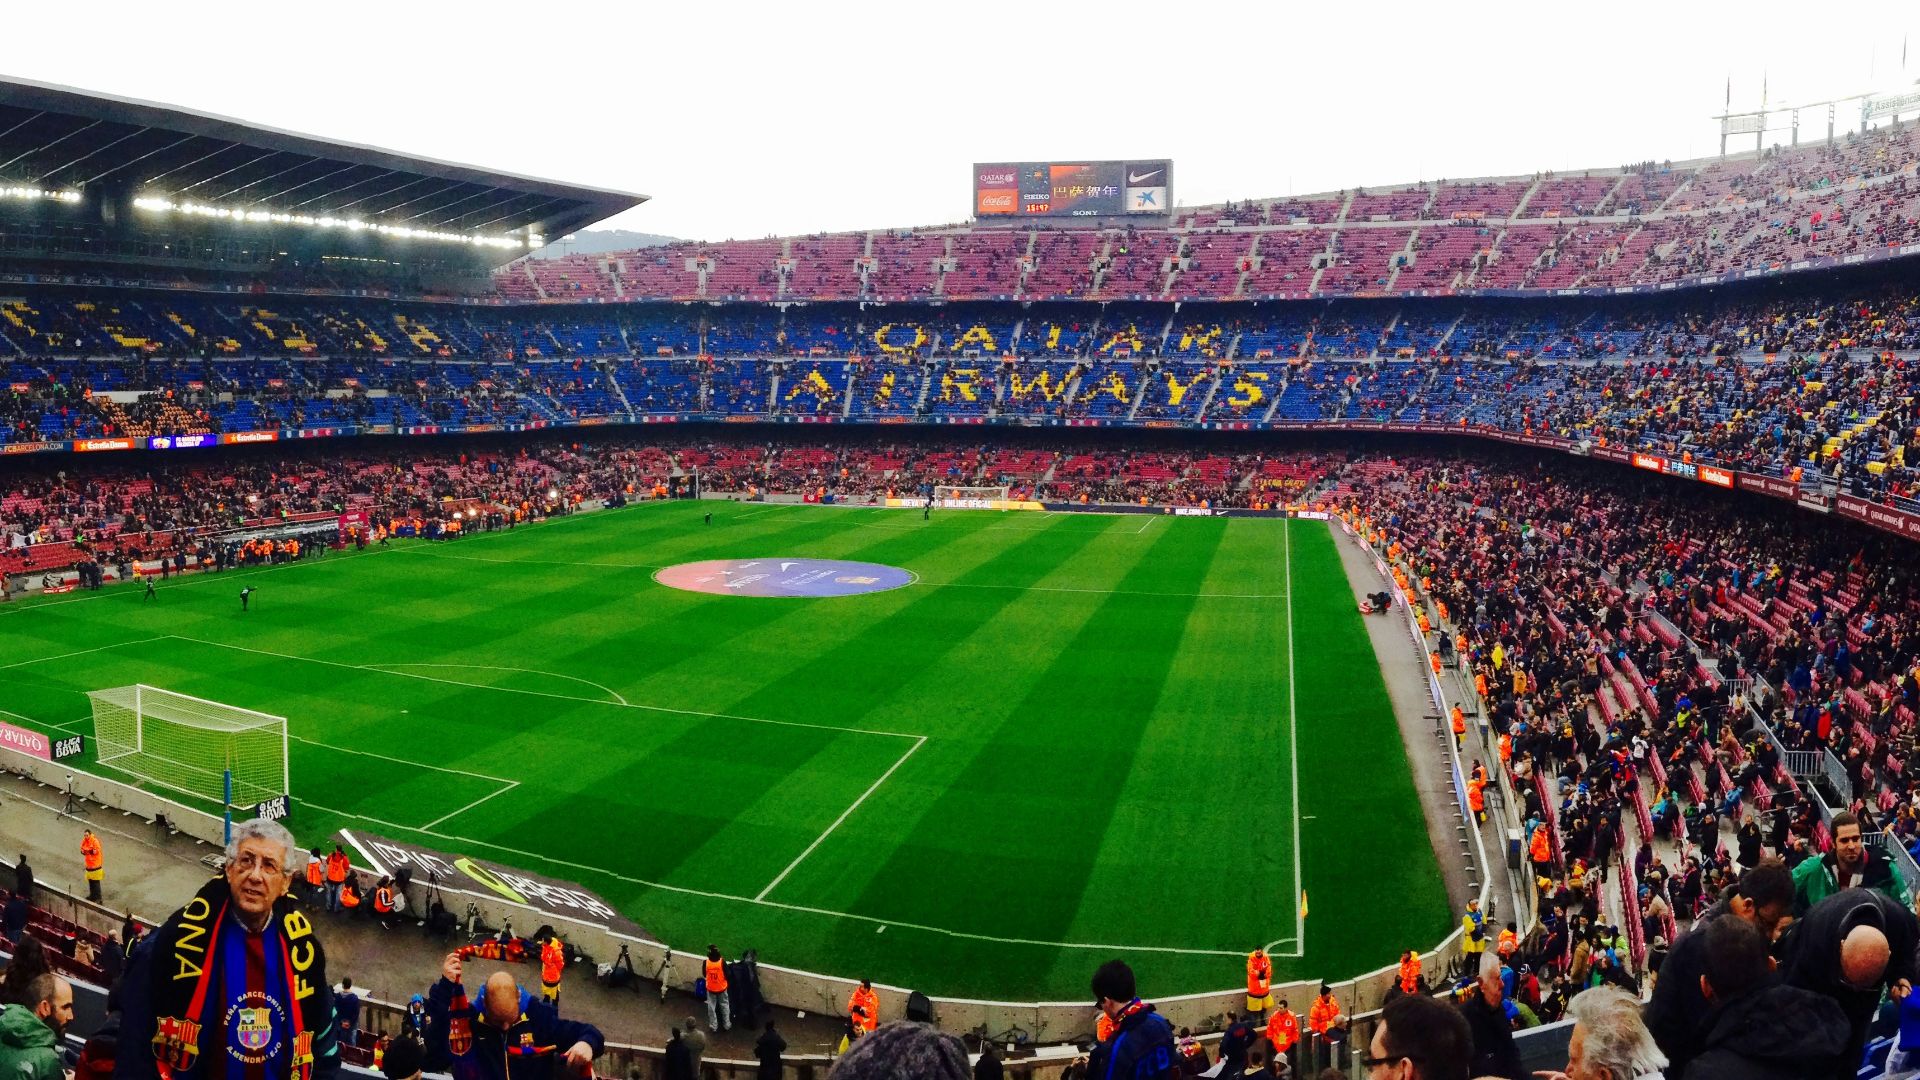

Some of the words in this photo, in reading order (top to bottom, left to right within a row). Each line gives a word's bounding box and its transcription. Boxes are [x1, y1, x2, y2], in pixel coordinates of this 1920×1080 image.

[4, 443, 64, 452] FCBARCELONA.COM
[902, 499, 920, 507] NUEVA
[944, 500, 967, 508] ONLINE
[4, 728, 42, 752] QATAR
[63, 736, 81, 748] LIGA
[55, 744, 82, 758] BBVA
[266, 796, 285, 811] LIGA
[259, 805, 287, 820] BBVA
[172, 896, 210, 981] ONA
[283, 909, 316, 1001] FCB
[236, 990, 286, 1022] BARCELONISTA
